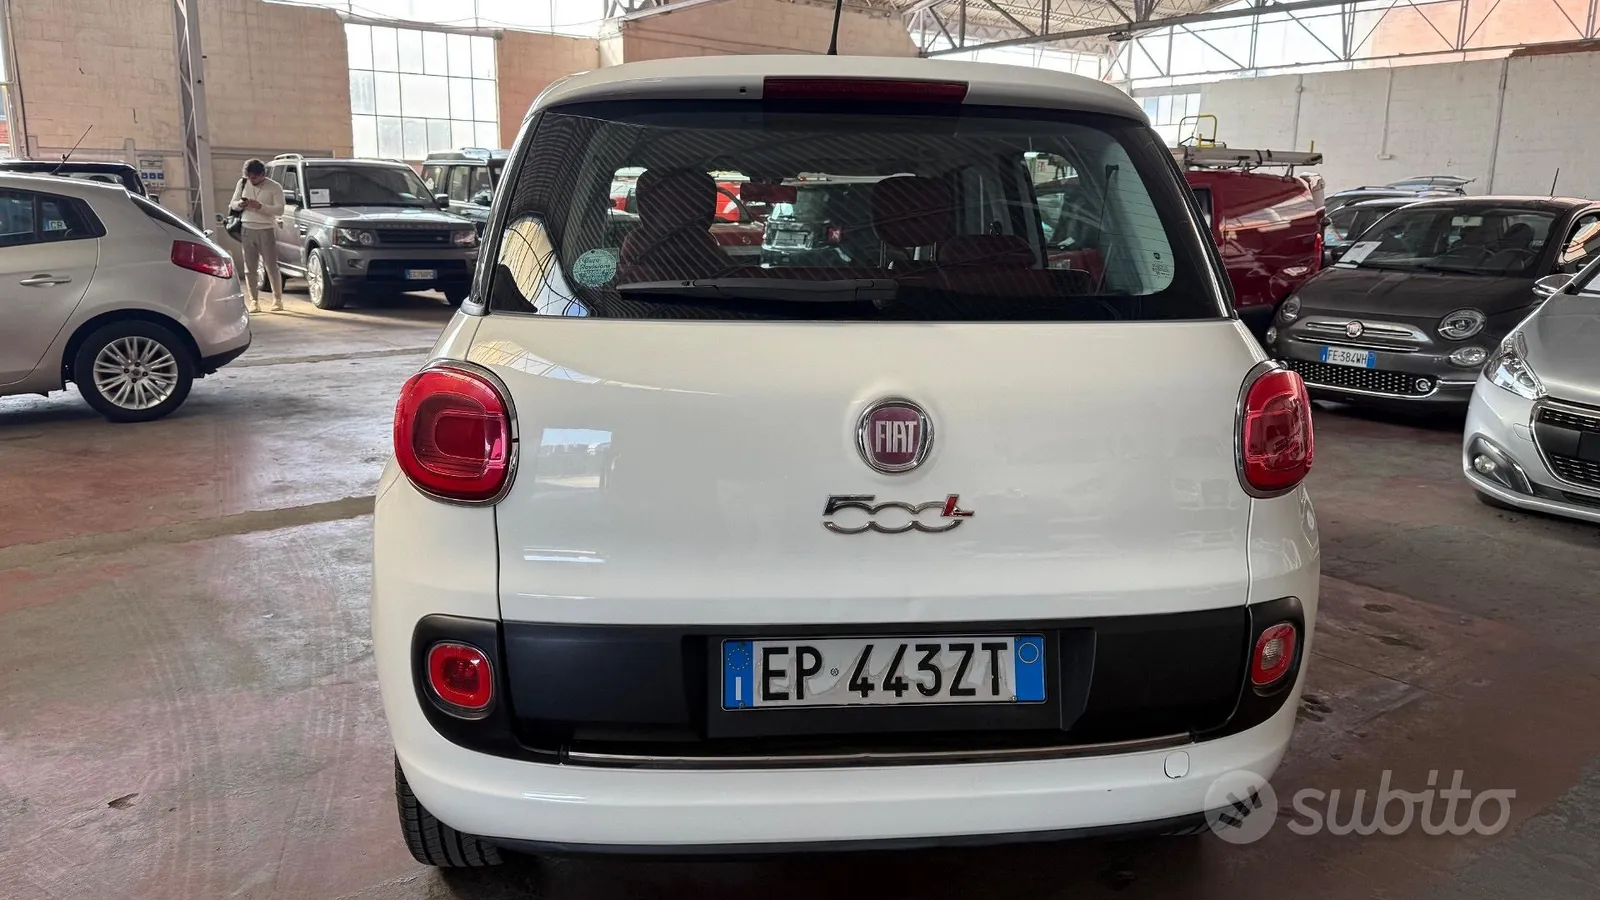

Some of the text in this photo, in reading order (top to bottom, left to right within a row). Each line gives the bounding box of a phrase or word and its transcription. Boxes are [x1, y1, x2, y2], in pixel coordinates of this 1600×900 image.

[875, 420, 918, 454] FIAT
[822, 493, 975, 535] 500L
[761, 642, 1009, 702] EP 443ZT
